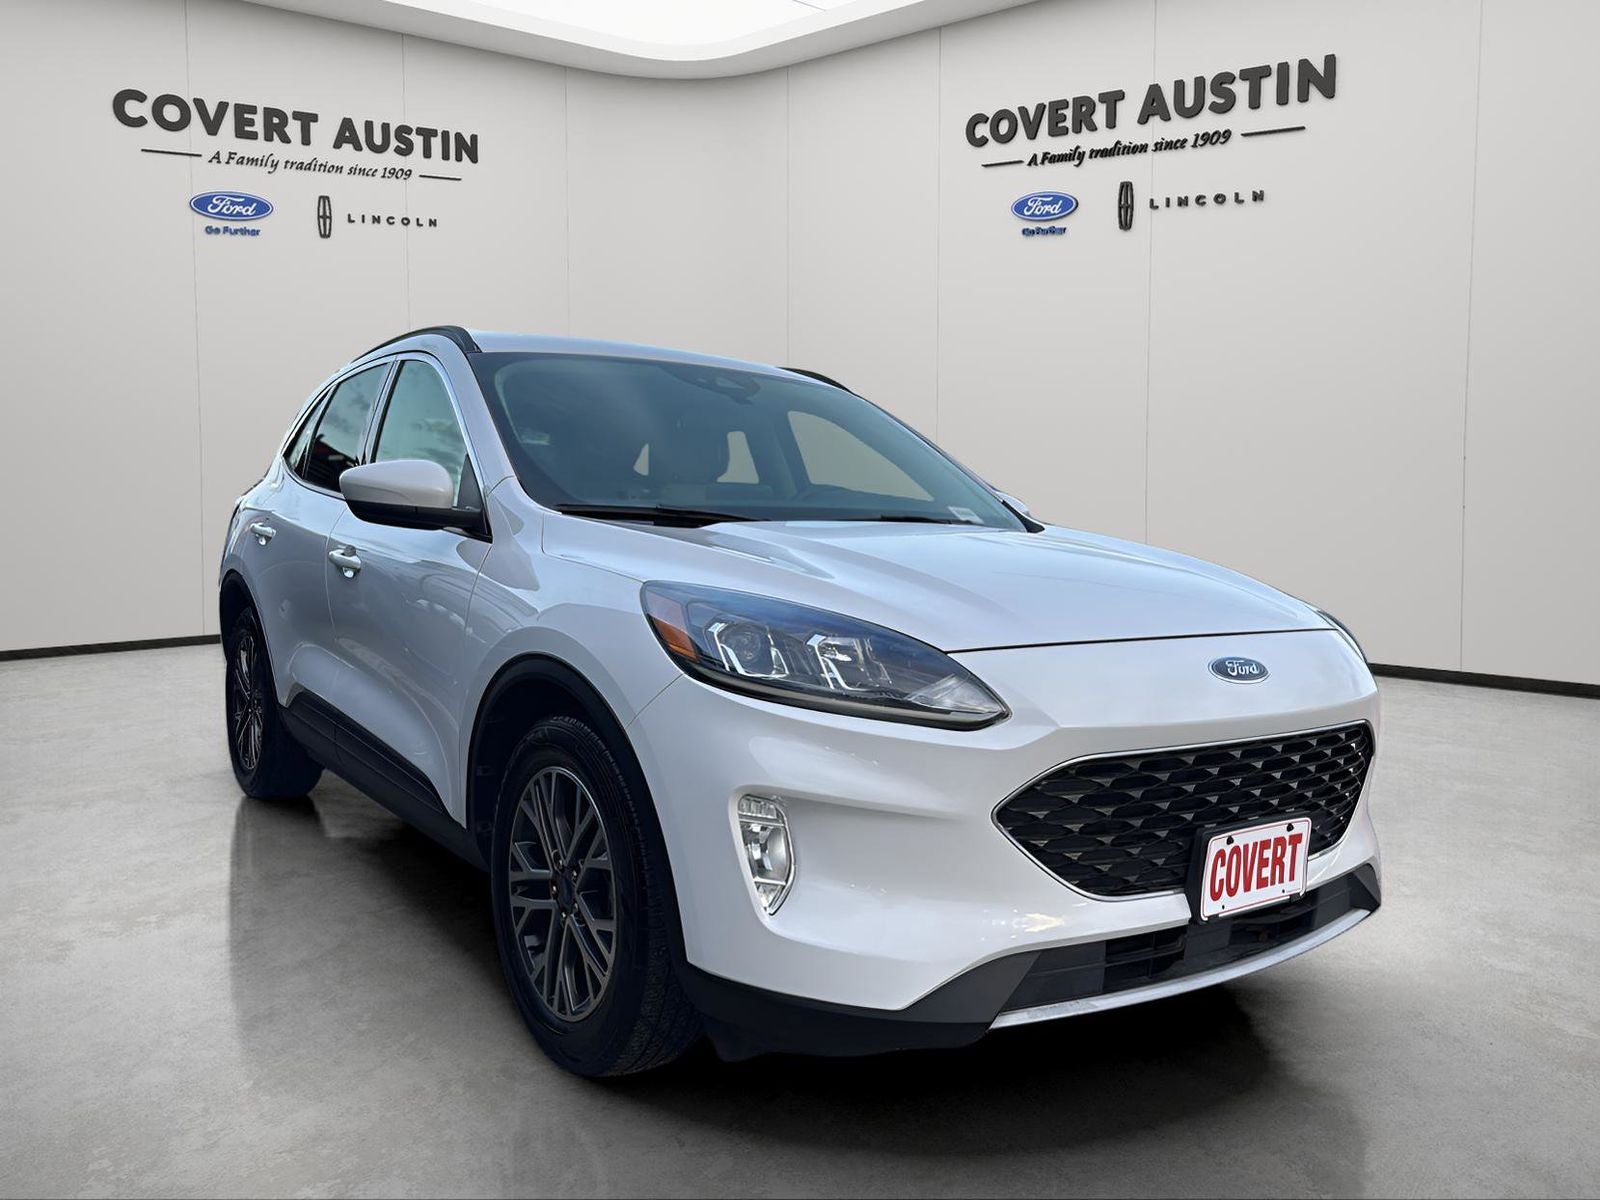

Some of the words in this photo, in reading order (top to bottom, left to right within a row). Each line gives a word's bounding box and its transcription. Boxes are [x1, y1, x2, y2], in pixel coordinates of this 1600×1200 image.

[965, 89, 1126, 148] COVERT
[1137, 53, 1337, 125] AUSTIN
[112, 88, 319, 146] COVERT
[332, 117, 479, 164] AUSTIN
[1027, 153, 1039, 166] A
[1040, 145, 1085, 167] Family
[1088, 140, 1148, 160] tradition
[1151, 137, 1188, 152] since
[1190, 128, 1232, 148] 1909
[208, 151, 222, 164] A
[225, 151, 279, 174] Family
[284, 157, 344, 175] tradition
[347, 163, 378, 177] since
[381, 166, 412, 181] 1909
[207, 195, 257, 216] Ford
[1023, 196, 1063, 216] Ford
[1150, 189, 1265, 210] LINCOLN
[347, 212, 438, 228] LINCOLN
[205, 225, 221, 235] Go
[222, 225, 261, 237] Further
[1225, 660, 1260, 677] Ford
[1209, 832, 1304, 902] COVERT
